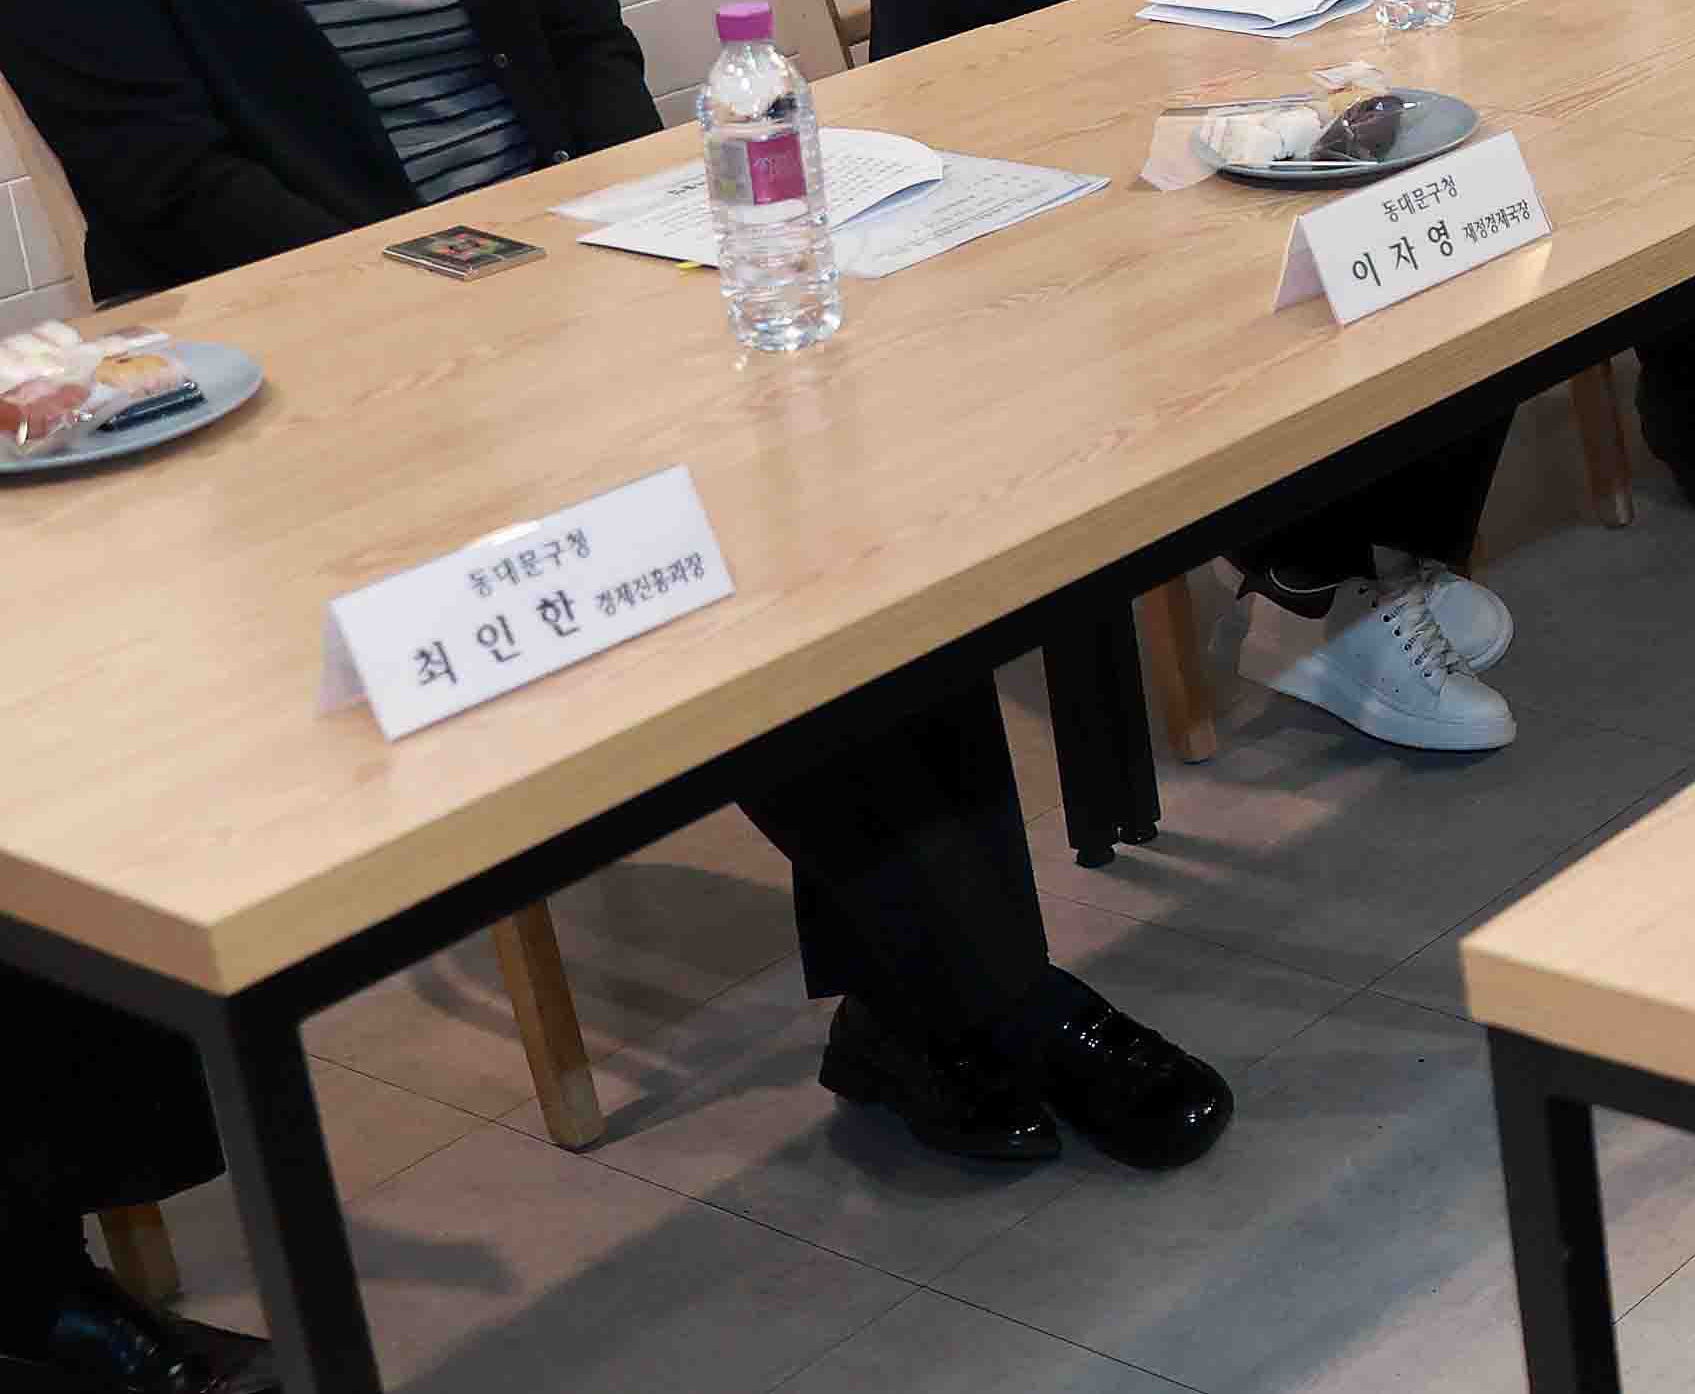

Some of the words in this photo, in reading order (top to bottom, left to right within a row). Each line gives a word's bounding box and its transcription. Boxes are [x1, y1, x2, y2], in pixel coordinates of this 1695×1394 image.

[1381, 174, 1459, 223] 동대문구청
[1460, 201, 1531, 244] 재정경제국장
[468, 528, 591, 598] 동대문구청
